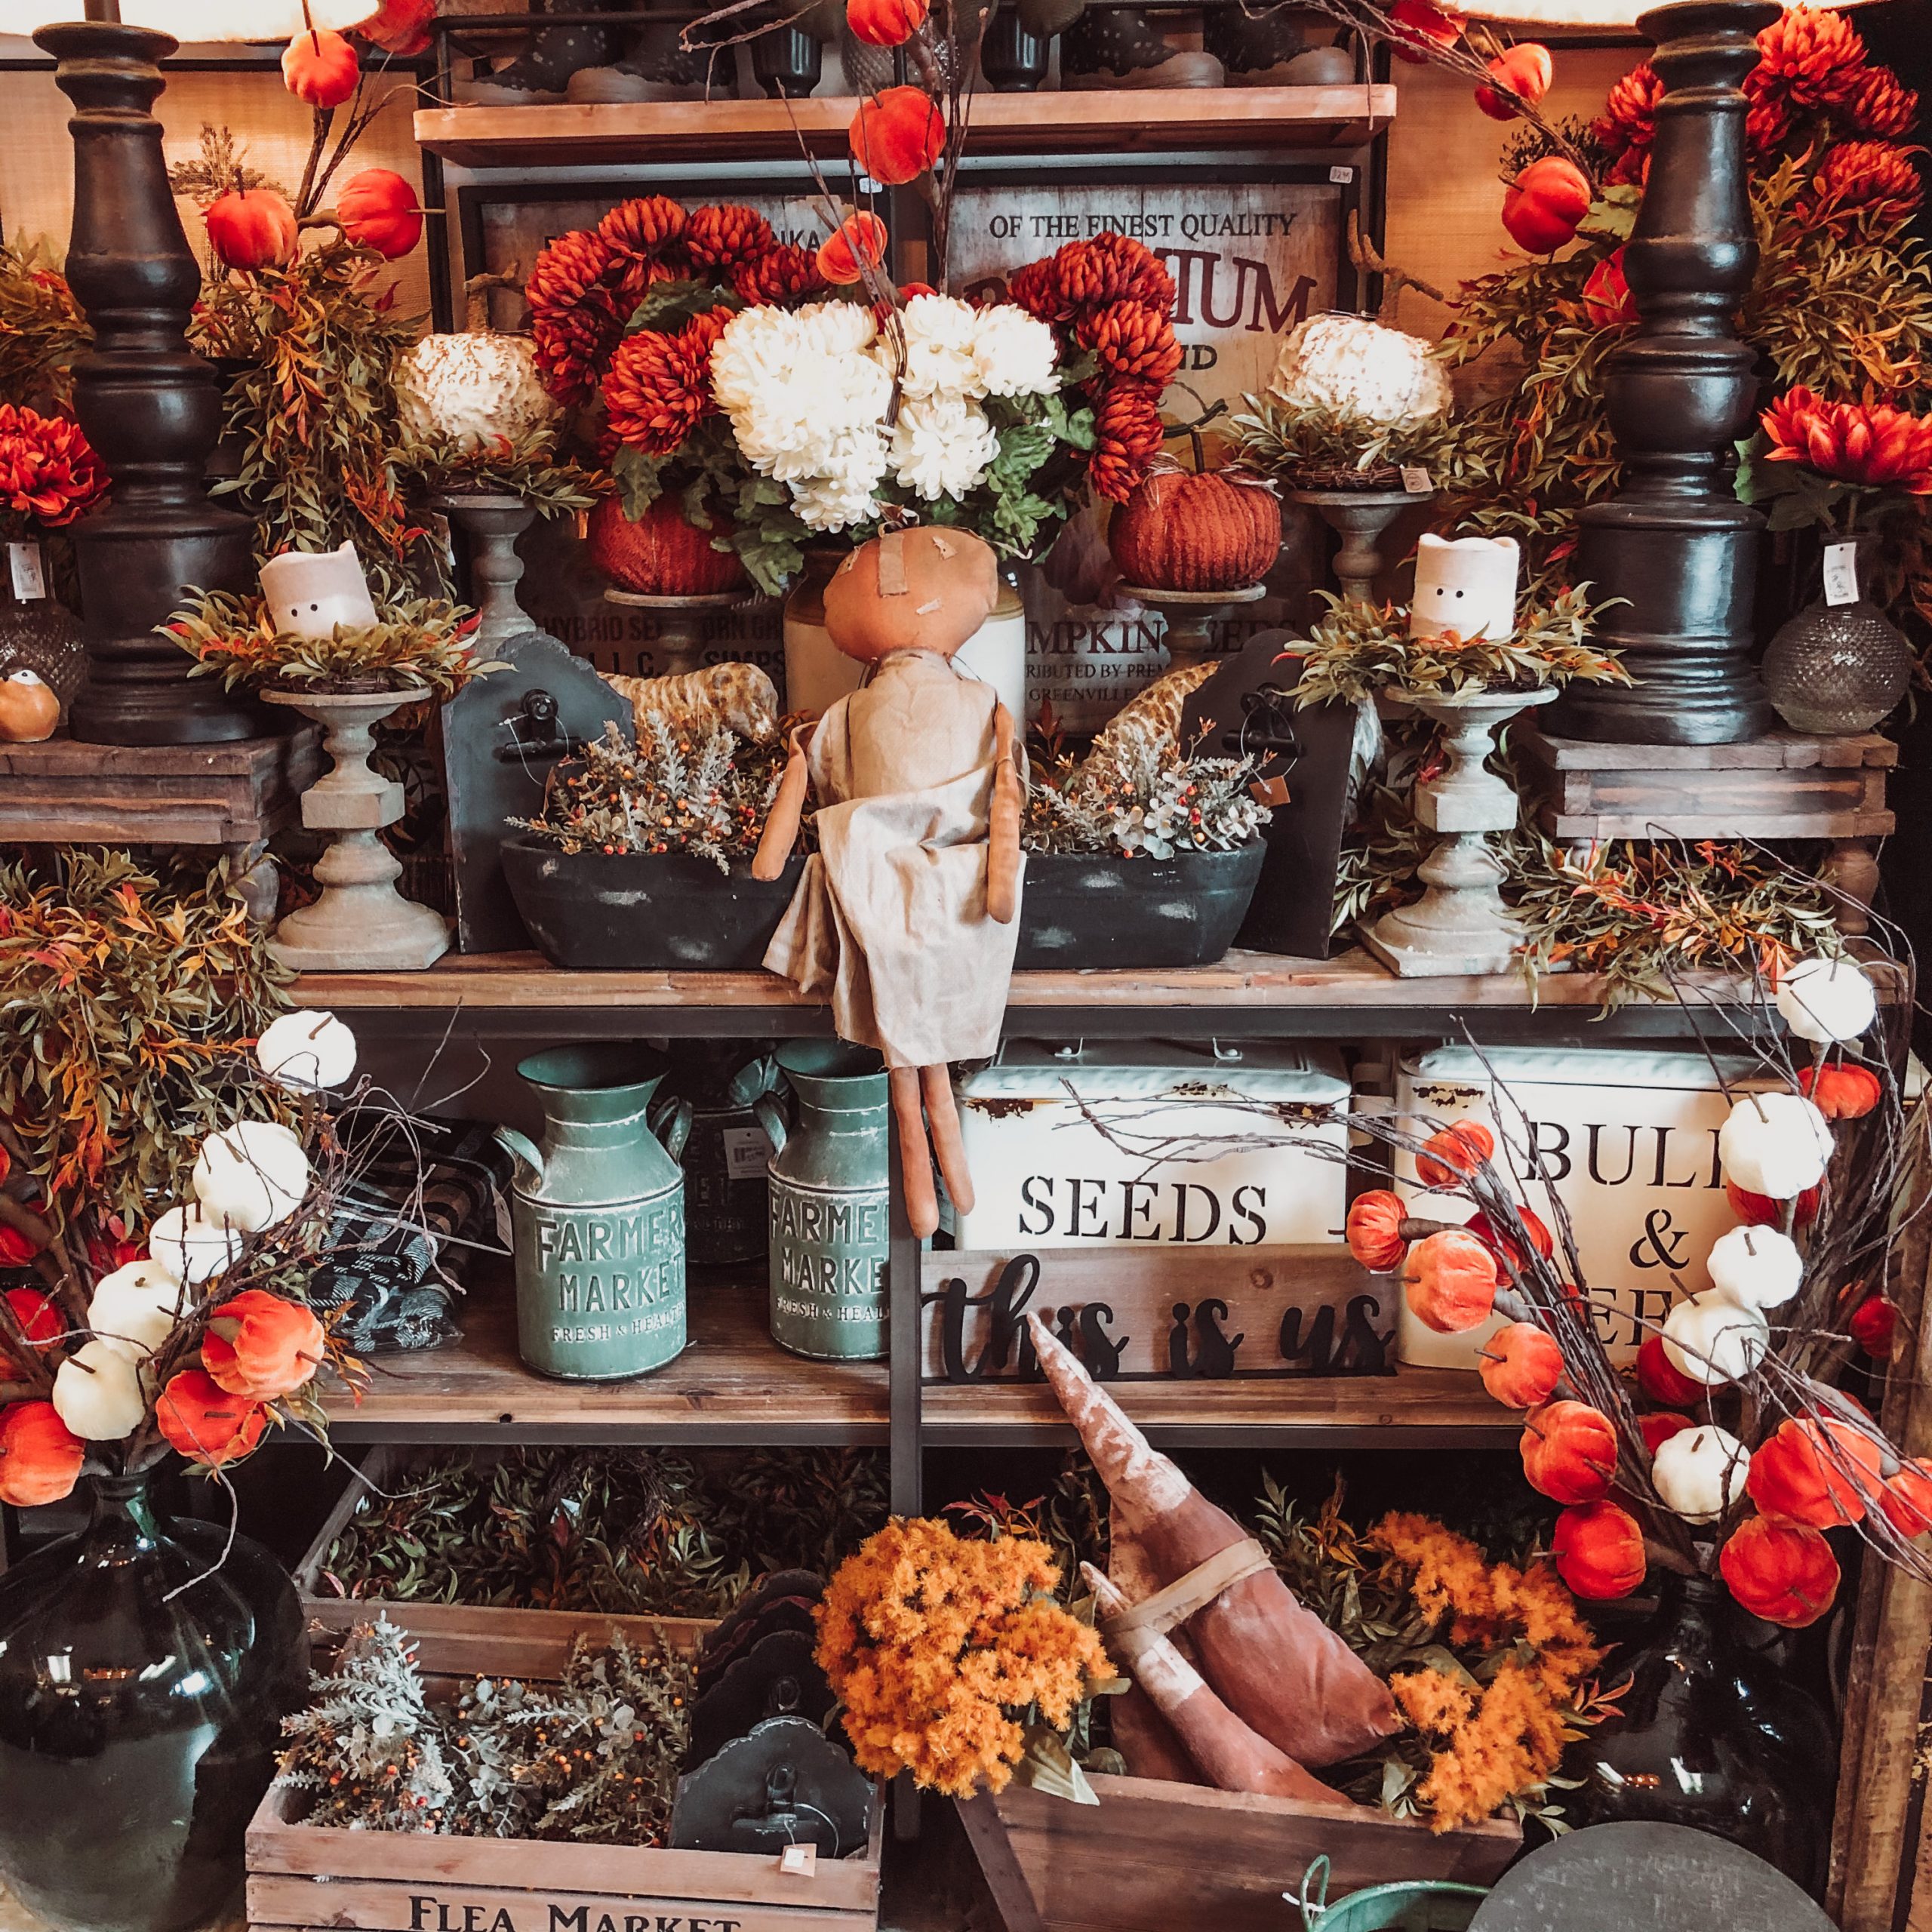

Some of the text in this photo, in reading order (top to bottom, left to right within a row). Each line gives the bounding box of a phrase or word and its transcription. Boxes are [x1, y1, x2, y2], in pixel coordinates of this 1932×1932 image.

[989, 214, 1297, 242] OF THE FINEST QUALITY
[1027, 620, 1164, 654] MPKIN
[1026, 663, 1097, 678] RIBUTED
[1100, 663, 1122, 678] BY
[1520, 1121, 1727, 1189] BUL
[771, 1187, 889, 1244] FARME
[1019, 1176, 1267, 1245] SEEDS
[535, 1203, 686, 1274] FARMER
[1629, 1208, 1690, 1269] &
[780, 1247, 886, 1295] MARKE
[551, 1325, 611, 1342] FRESH
[615, 1324, 628, 1336] &
[777, 1297, 819, 1319] FRESH
[838, 1306, 885, 1321] HEAL
[921, 1254, 1396, 1384] this is us
[408, 1895, 516, 1932] FLEA
